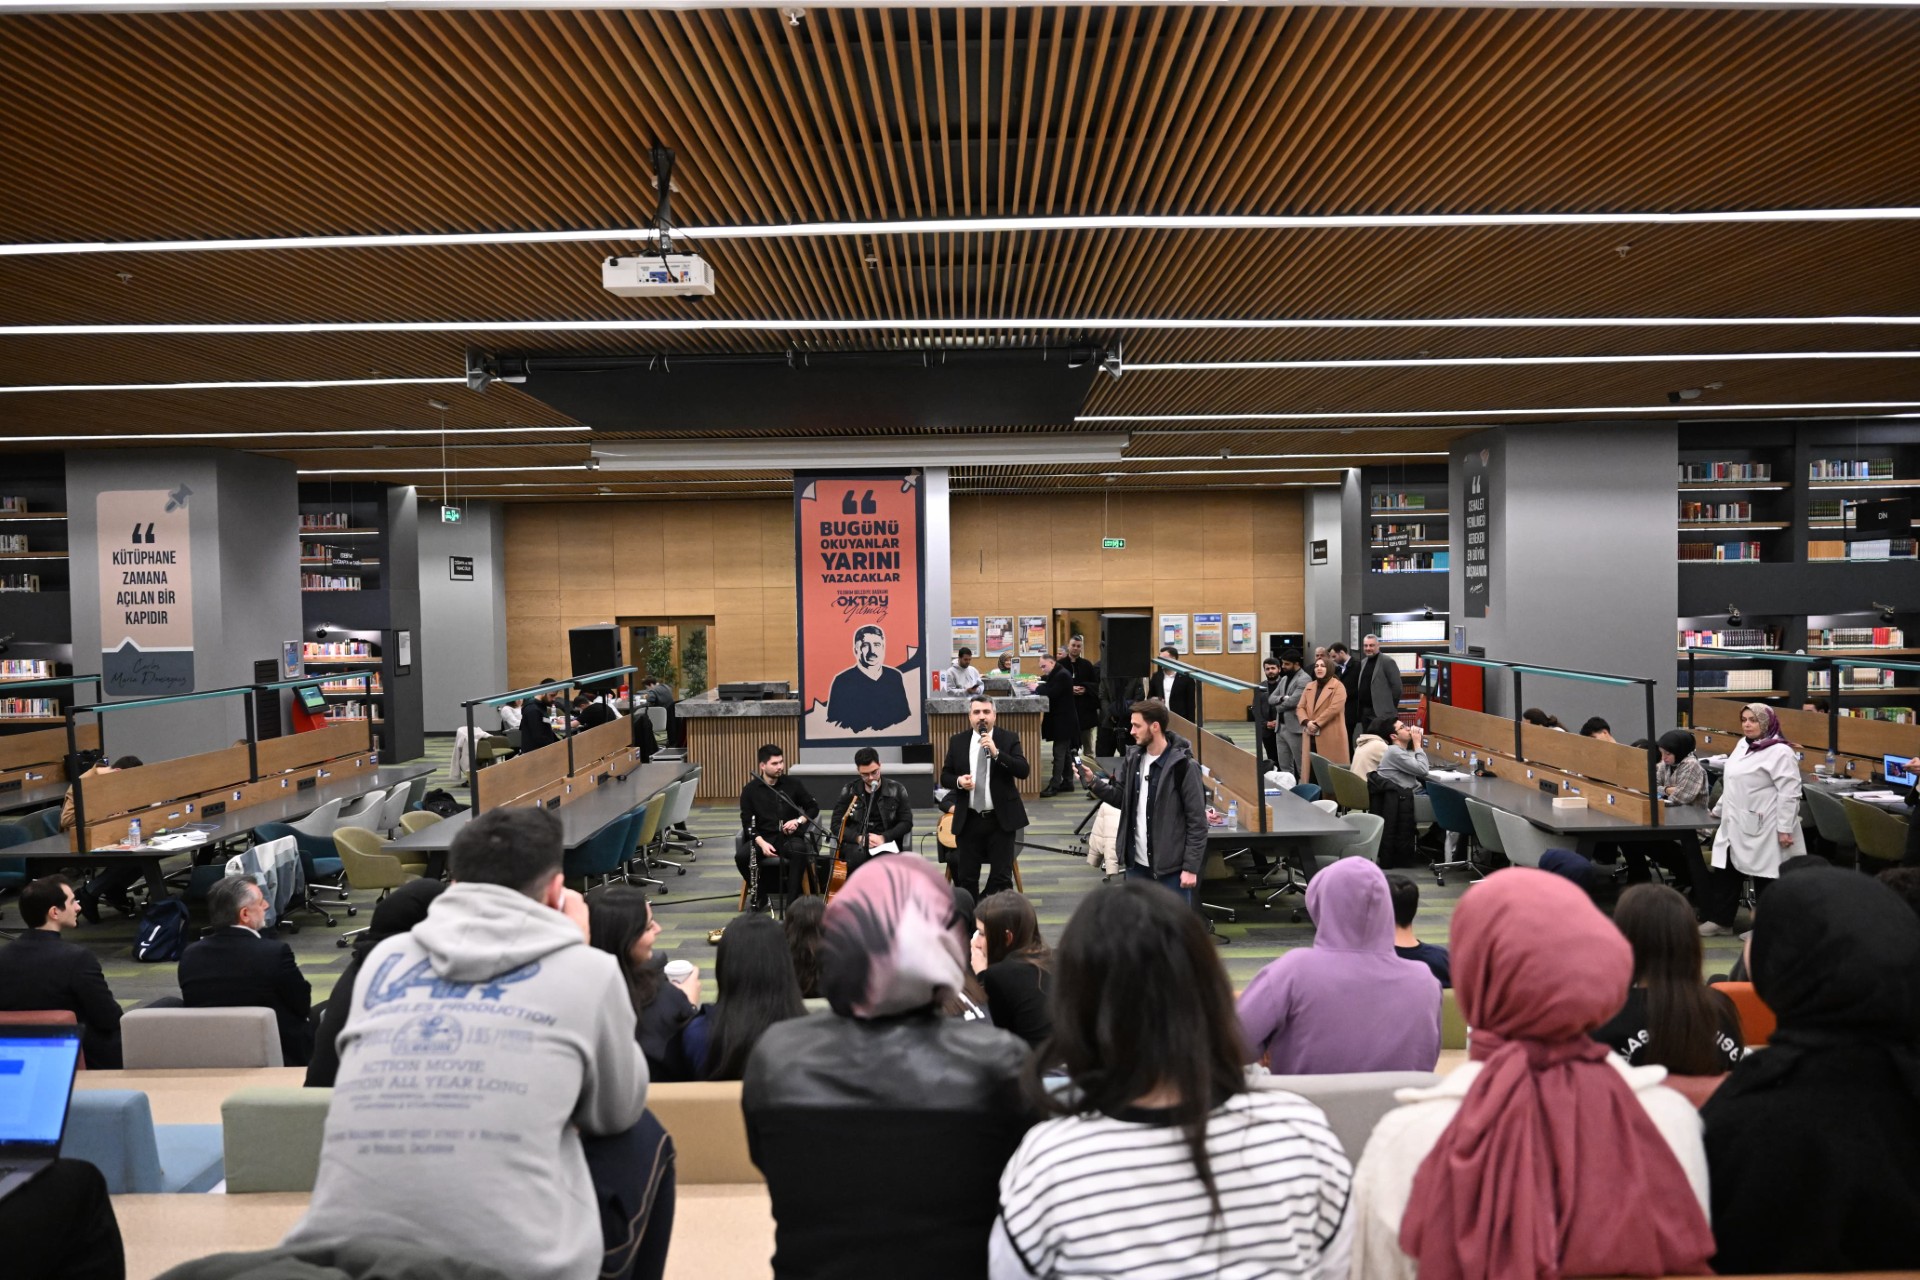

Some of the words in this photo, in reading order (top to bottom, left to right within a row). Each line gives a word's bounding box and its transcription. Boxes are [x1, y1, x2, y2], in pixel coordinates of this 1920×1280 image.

[1878, 511, 1888, 520] DİN
[820, 520, 899, 536] BUGÜNÜ
[820, 538, 899, 549] OKUYANLAR
[112, 548, 176, 565] KÜTÜPHANE
[820, 552, 900, 570] YARINI
[122, 571, 168, 585] ZAMANA
[821, 573, 900, 583] YAZACAKLAR
[116, 591, 155, 607] AÇILAN
[158, 588, 176, 604] BİR
[837, 595, 889, 607] OKTAY
[125, 610, 168, 625] KAPIDIR
